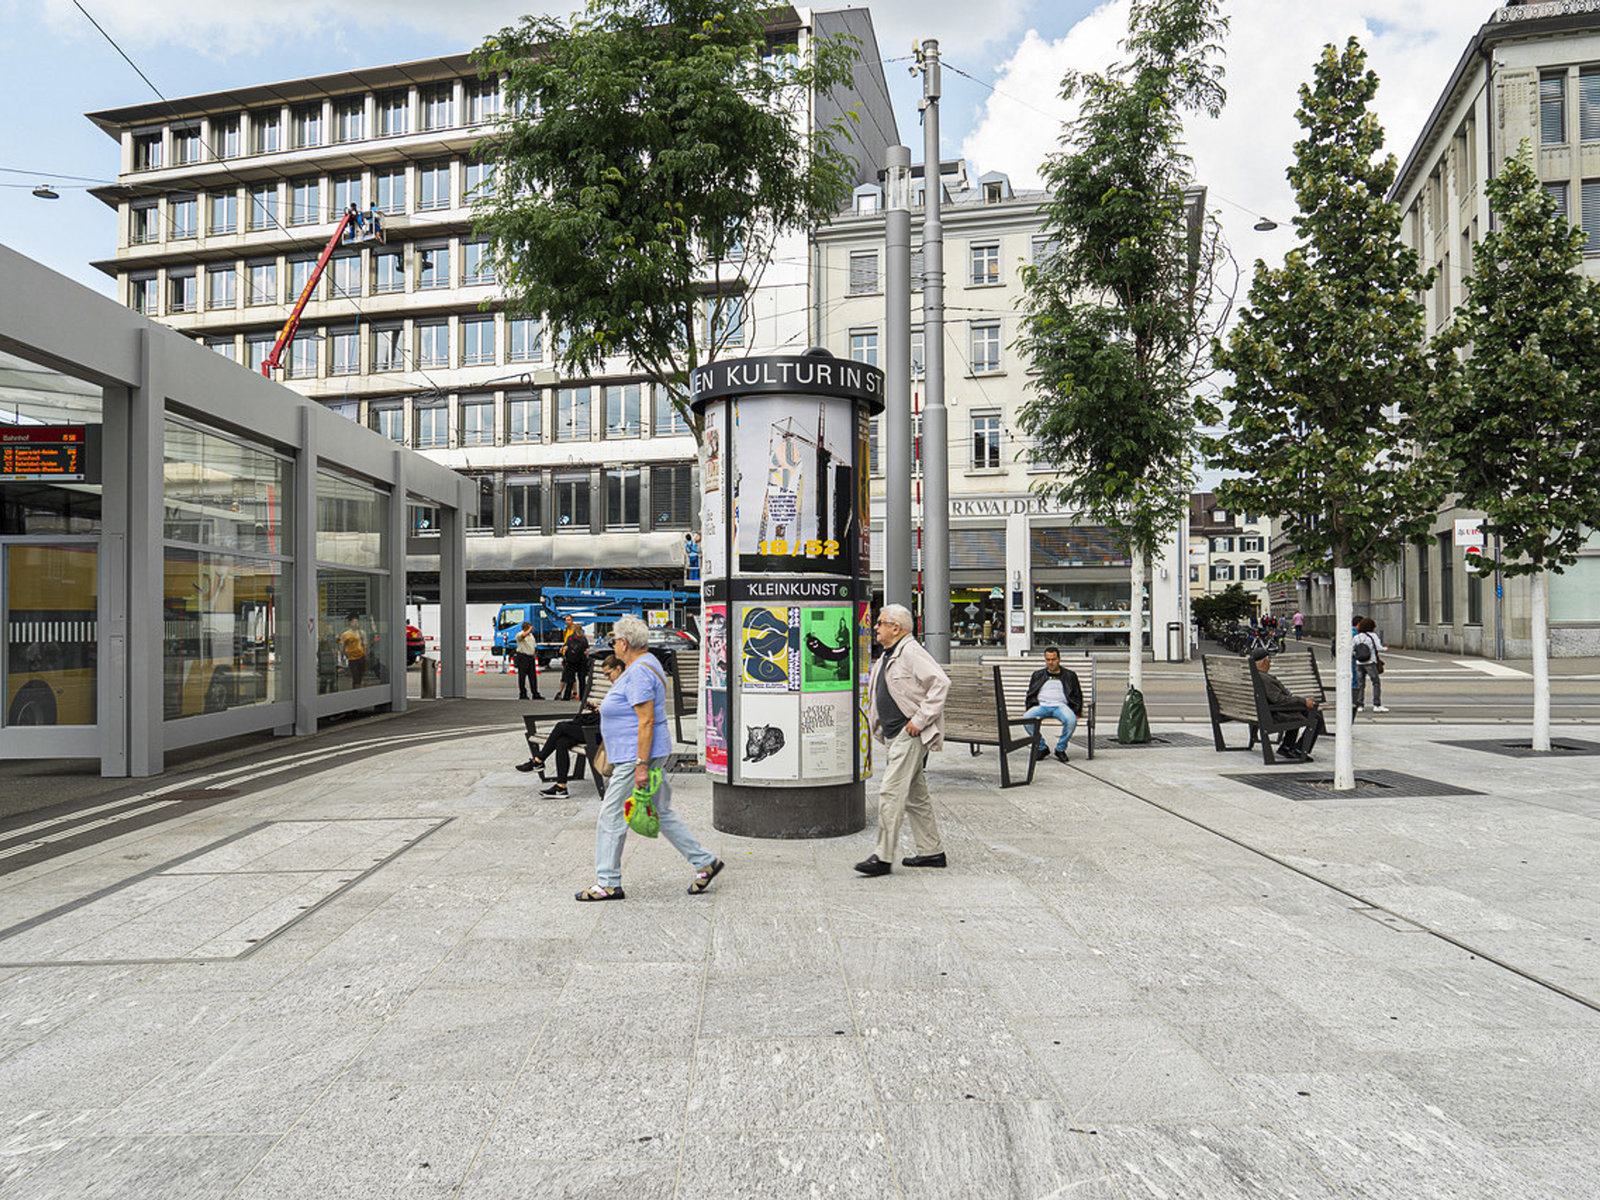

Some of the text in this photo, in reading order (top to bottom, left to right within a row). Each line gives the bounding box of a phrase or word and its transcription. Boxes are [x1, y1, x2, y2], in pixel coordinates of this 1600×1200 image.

[692, 369, 713, 396] EN
[727, 363, 832, 387] KULTUR
[840, 366, 861, 389] IN
[952, 500, 1048, 514] RKWALDER
[748, 583, 838, 596] KLEINKUNST
